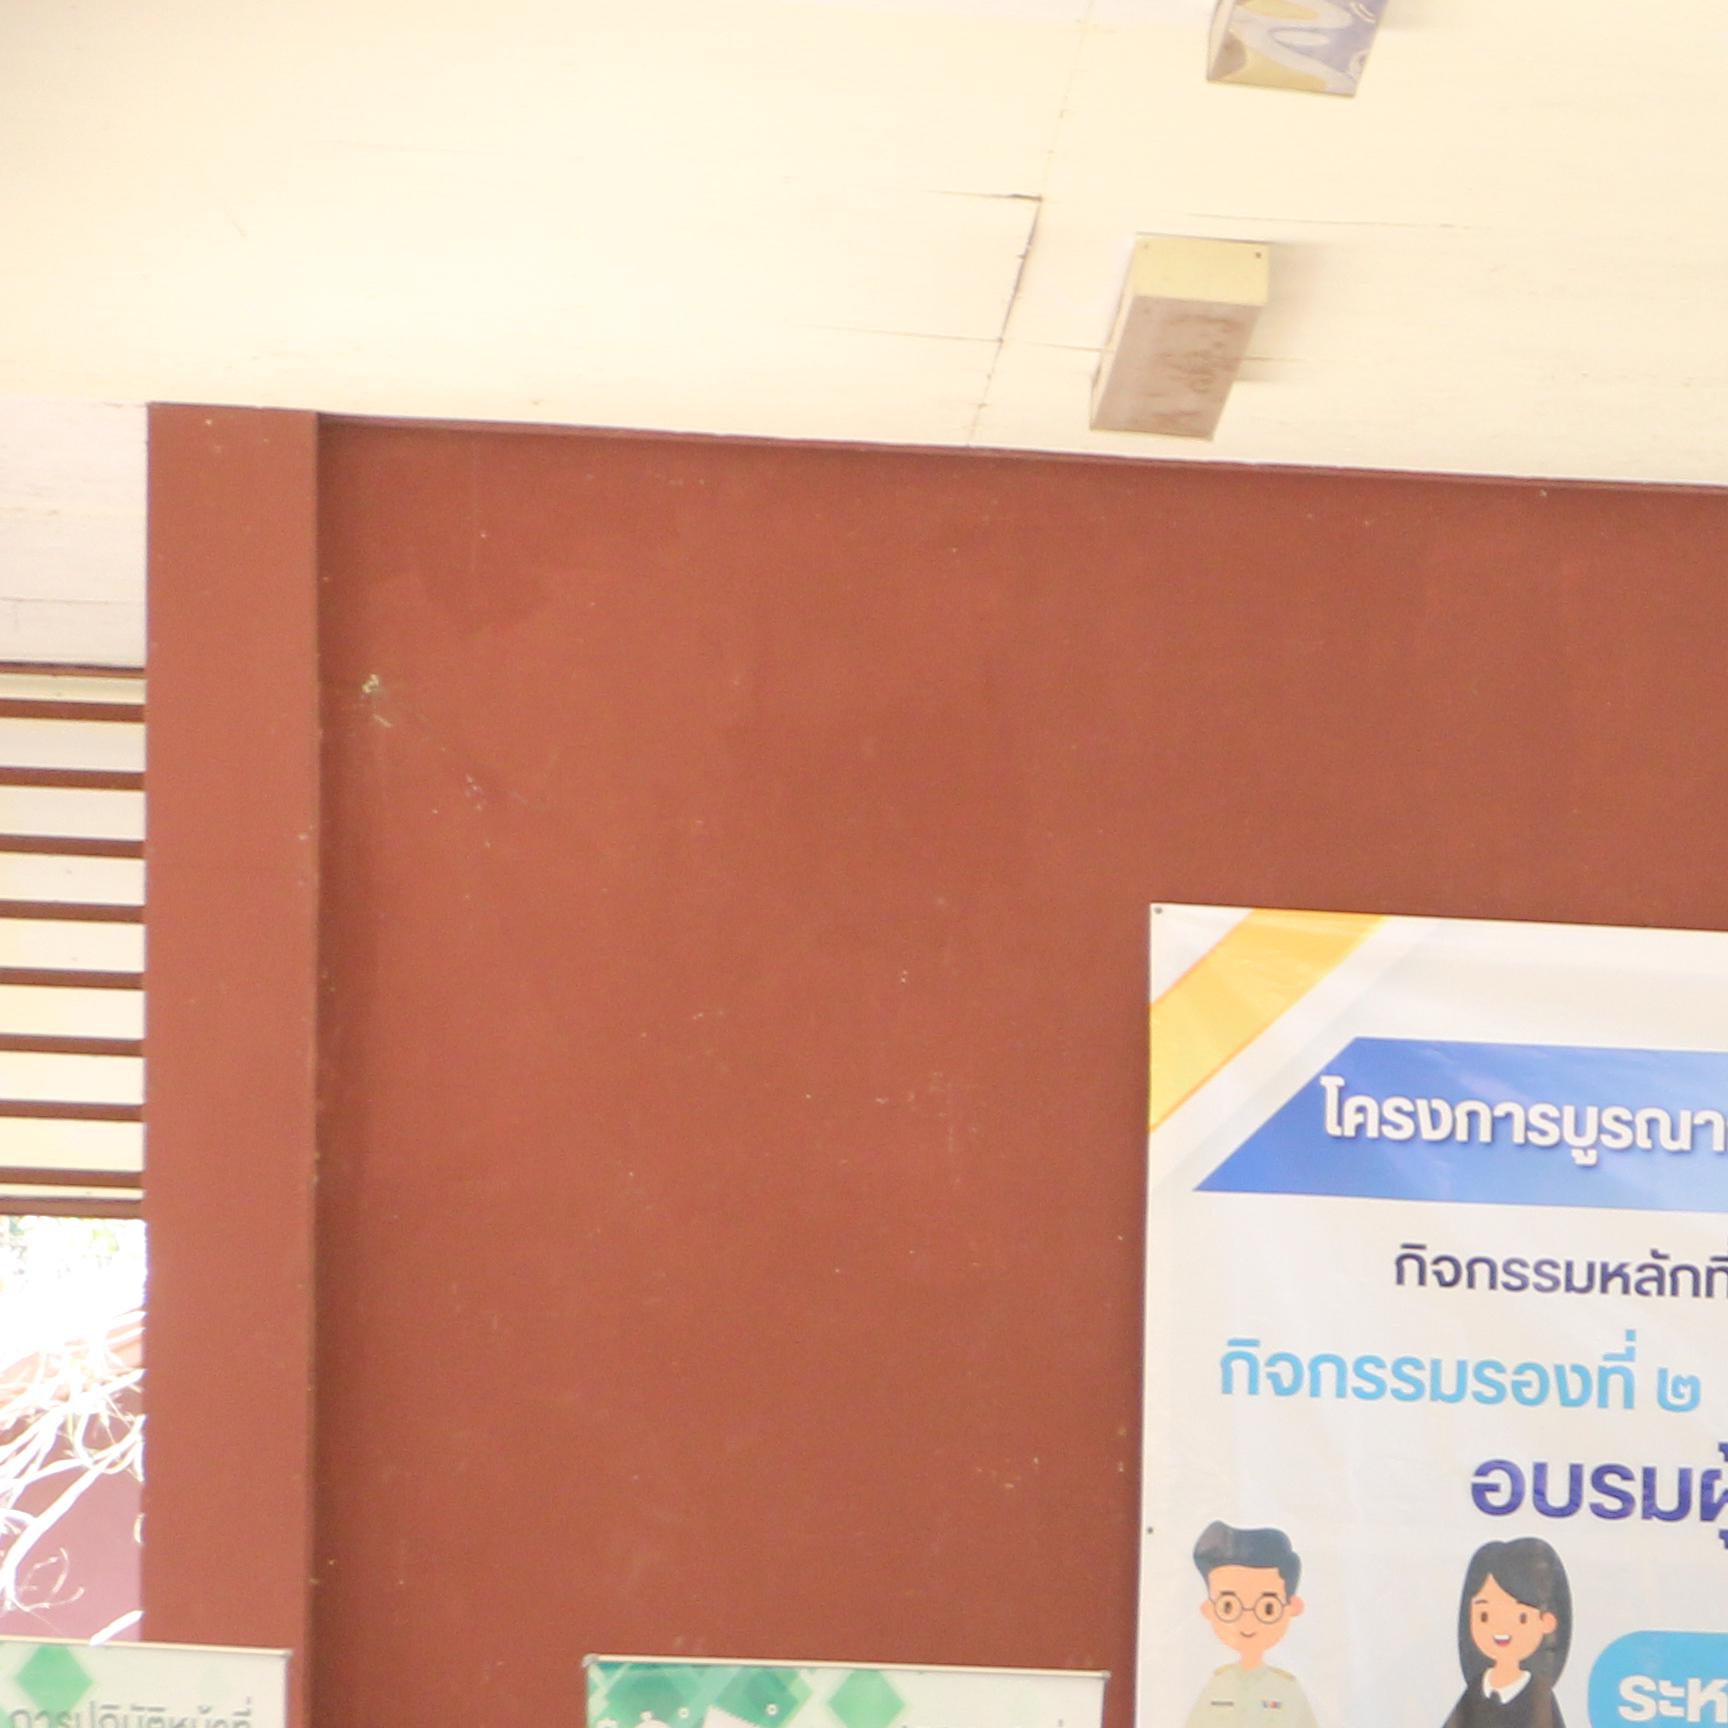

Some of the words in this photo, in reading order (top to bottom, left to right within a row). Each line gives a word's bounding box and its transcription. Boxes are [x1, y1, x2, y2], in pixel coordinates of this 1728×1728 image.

[1219, 1330, 1635, 1411] กิจกรรมรองที่
[1656, 1366, 1701, 1413] ๒
